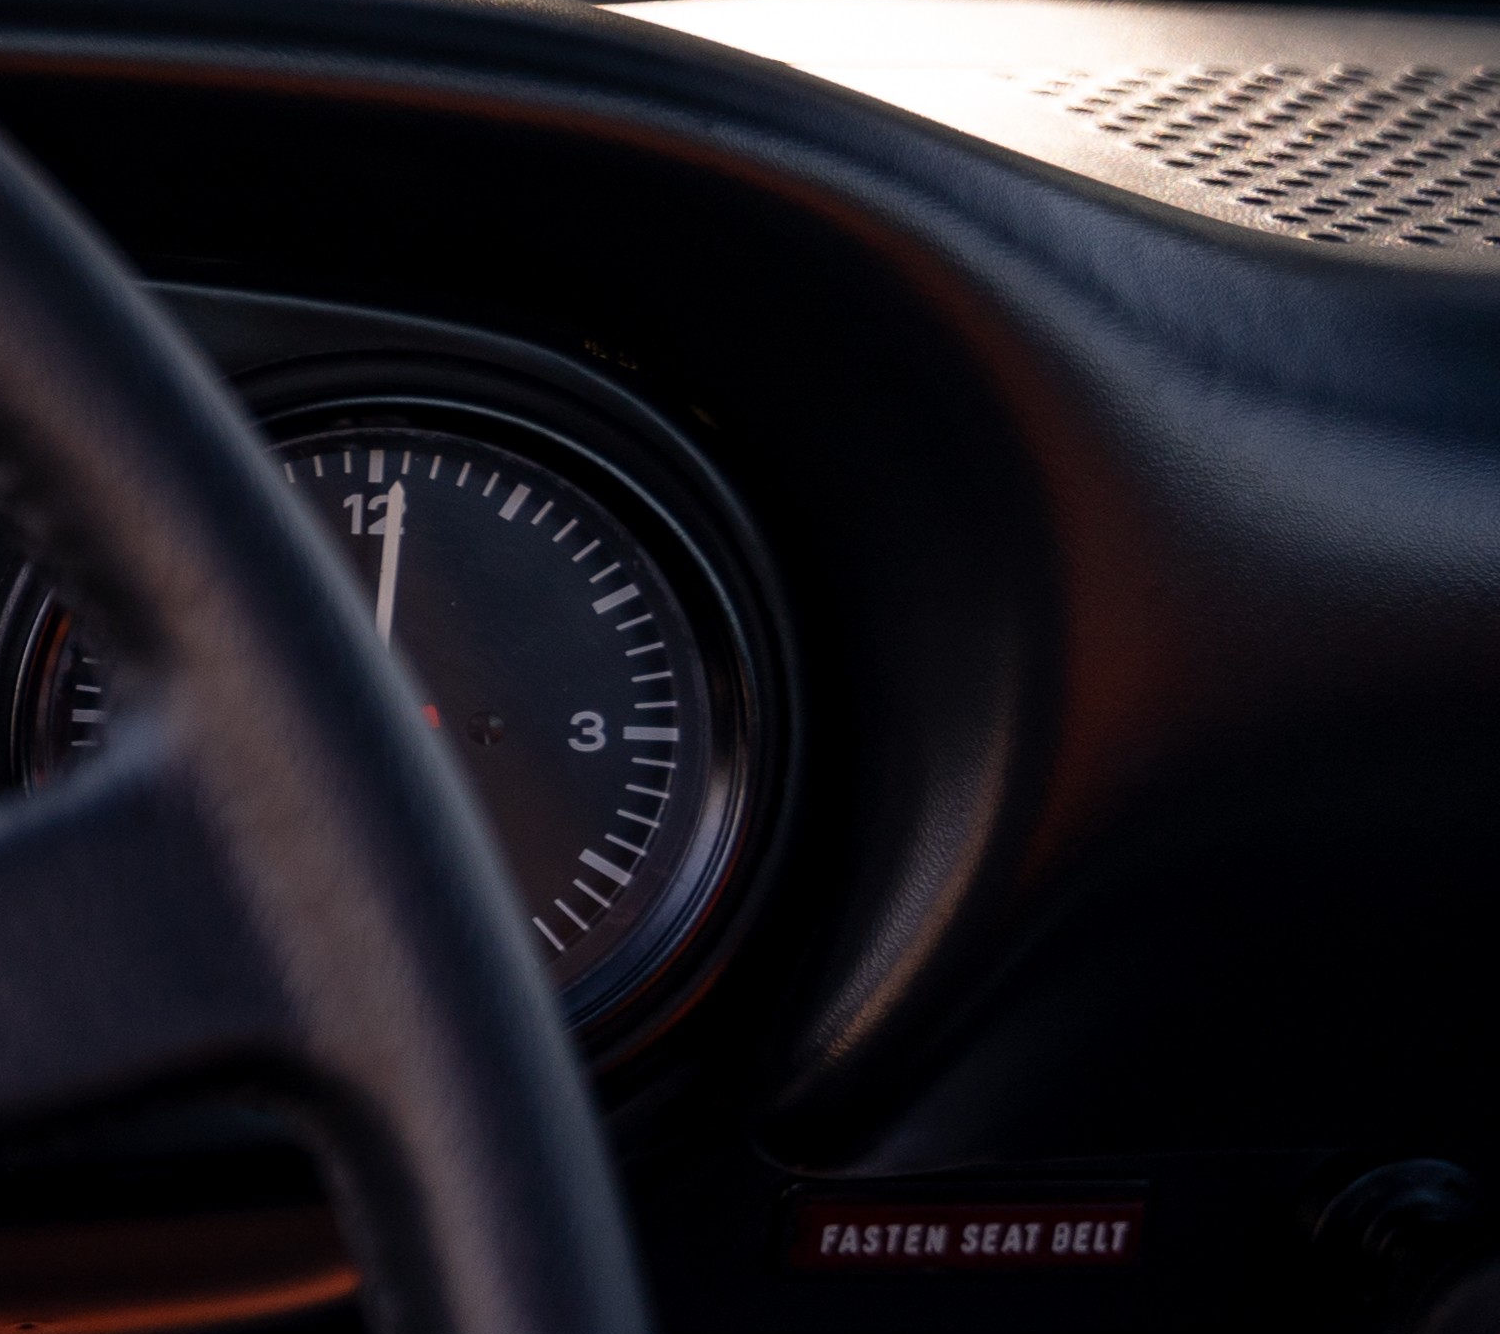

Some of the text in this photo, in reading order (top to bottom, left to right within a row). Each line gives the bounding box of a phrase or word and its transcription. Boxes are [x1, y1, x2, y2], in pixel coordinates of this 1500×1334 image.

[567, 711, 607, 753] 3
[820, 1220, 1129, 1256] FASTEN SEAT BELT
